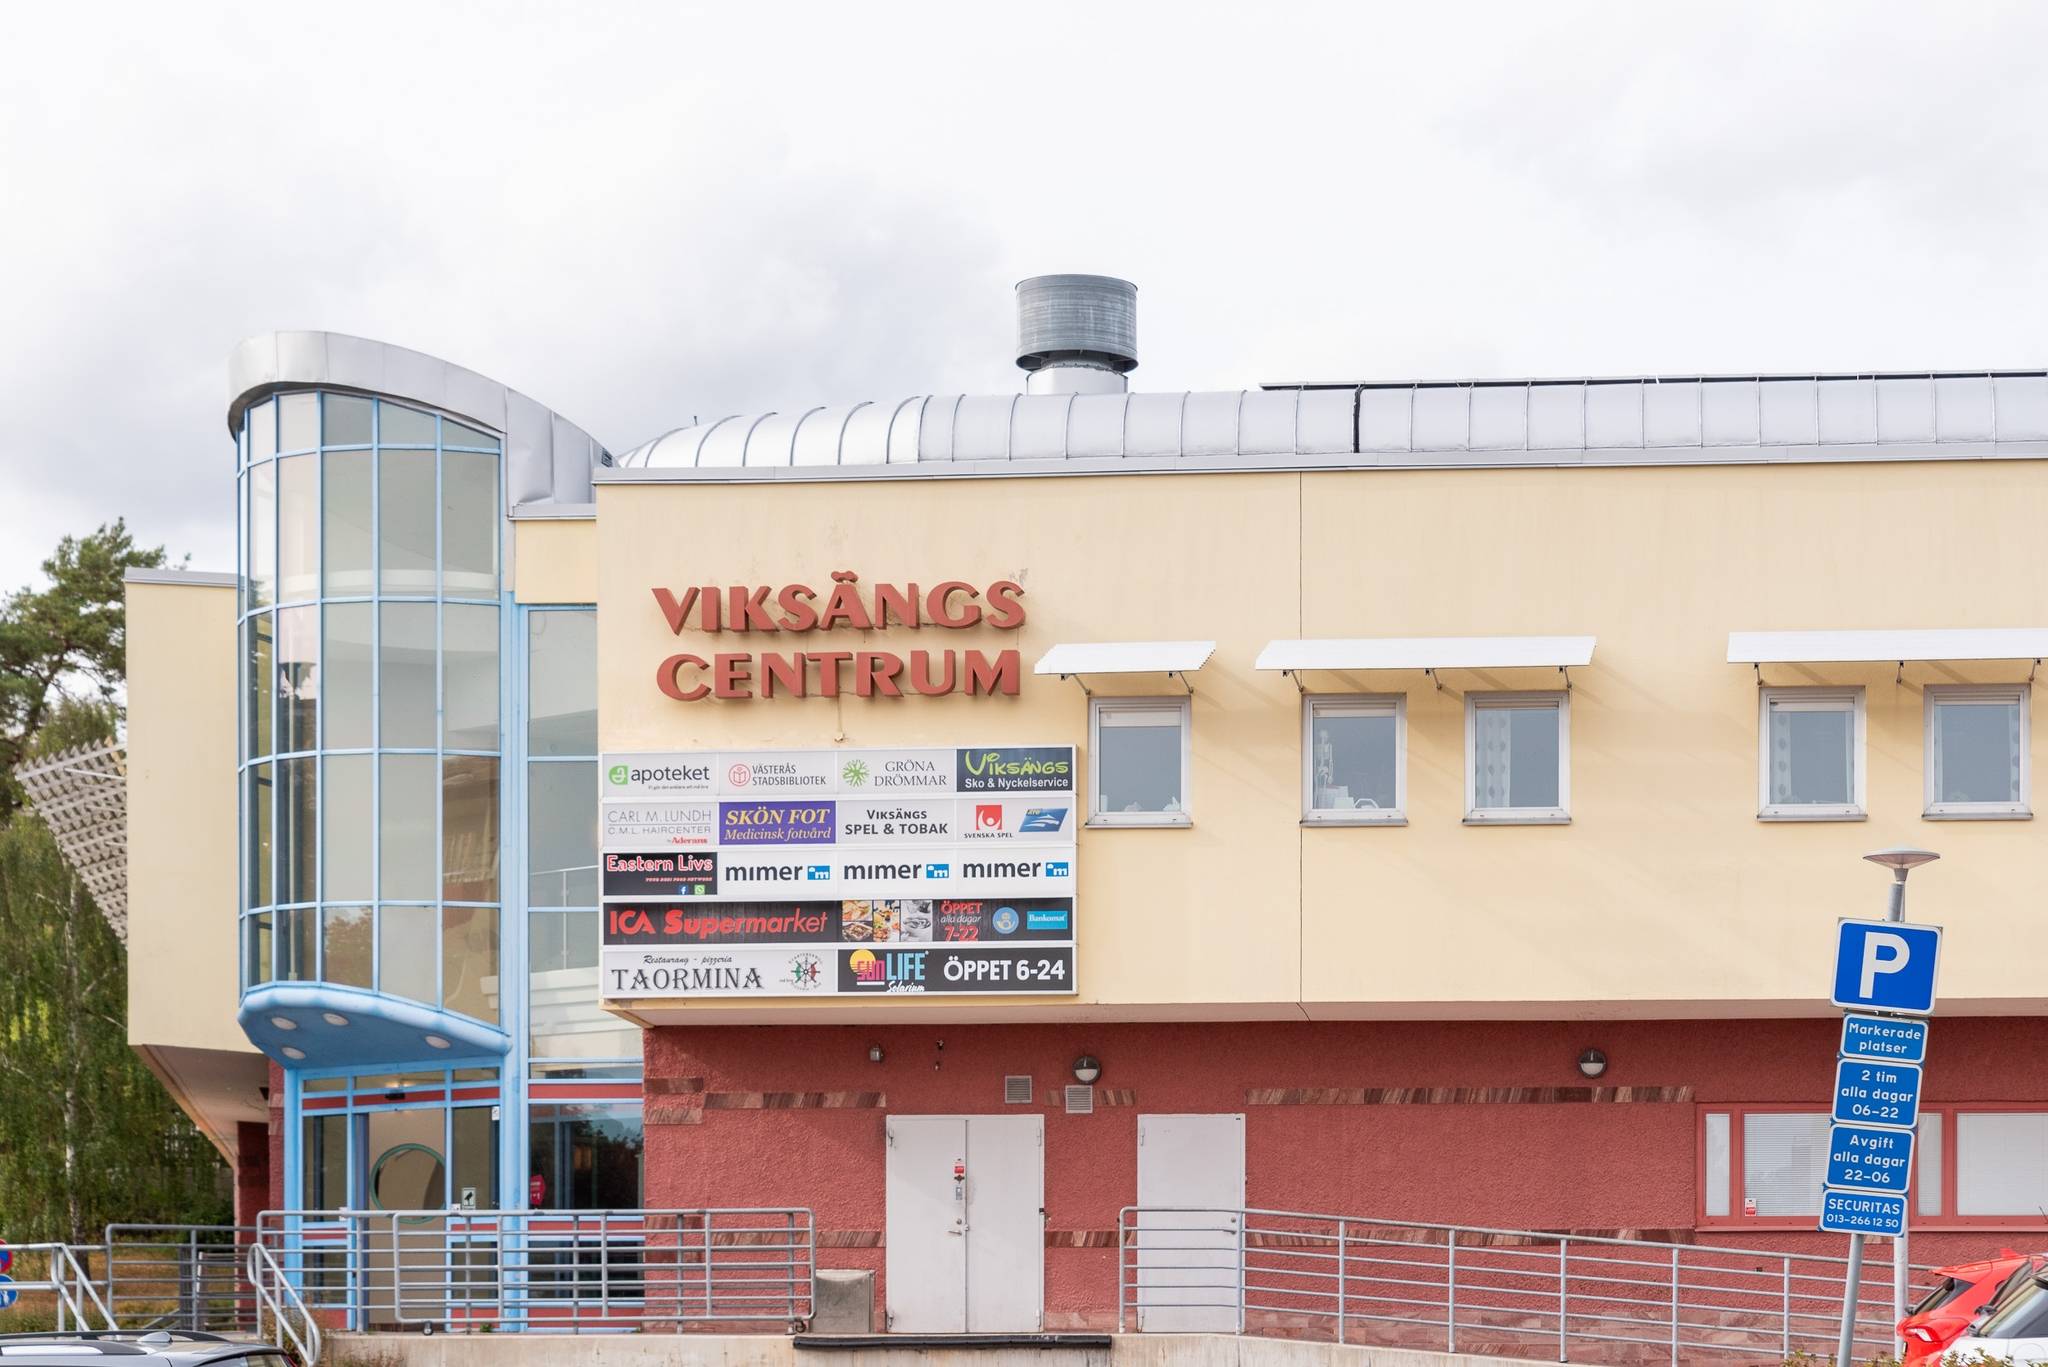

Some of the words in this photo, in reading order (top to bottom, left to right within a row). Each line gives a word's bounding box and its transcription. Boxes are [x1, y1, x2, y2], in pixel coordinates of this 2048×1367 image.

[651, 571, 1026, 636] VIKSÄNGS
[656, 650, 1021, 702] CENTRUM
[752, 765, 797, 775] VÄSTERÅS
[885, 758, 935, 772] GRÖNA
[631, 766, 710, 785] apoteket
[752, 775, 827, 786] STADSBIBLIOTEK
[874, 774, 948, 787] DRÖMMAR
[965, 778, 985, 789] Sko
[987, 778, 995, 788] &
[998, 777, 1069, 790] Nyckelservice
[608, 810, 641, 823] CARL
[645, 810, 662, 823] M.
[665, 809, 712, 822] LUNDH
[725, 806, 785, 825] SKÖN
[788, 809, 831, 824] FOT
[643, 826, 711, 835] HAIRCENTER
[724, 827, 784, 841] Medicinsk
[785, 826, 831, 842] fotvård
[845, 824, 879, 835] SPEL
[883, 824, 895, 835] &
[899, 823, 948, 835] TOBAK
[606, 855, 674, 872] Eastern
[677, 854, 713, 872] Livs
[963, 862, 1041, 878] mimer
[725, 865, 803, 881] mimer
[843, 863, 922, 880] mimer
[941, 900, 983, 914] ÖPPET
[610, 910, 656, 935] ICA
[663, 907, 828, 940] Supermarket
[940, 914, 956, 924] alla
[957, 914, 982, 924] dagar
[944, 925, 979, 942] 7-22
[643, 955, 689, 966] Restaurang
[701, 956, 733, 966] pizzeria
[943, 955, 1012, 981] ÖPPET
[1016, 959, 1065, 981] 6-24
[1859, 931, 1911, 999] P
[611, 967, 764, 991] TAORMINA
[886, 980, 925, 992] Solarium
[1849, 1022, 1922, 1040] Markerade
[1859, 1040, 1907, 1053] platser
[1861, 1069, 1871, 1081] 2
[1876, 1071, 1897, 1083] tim
[1841, 1086, 1867, 1098] alla
[1872, 1087, 1914, 1104] dagar
[1852, 1104, 1899, 1119] 06-22
[1850, 1135, 1894, 1150] Avgift
[1833, 1151, 1859, 1163] alla
[1864, 1153, 1906, 1169] dagar
[1844, 1169, 1890, 1184] 22-06
[1828, 1198, 1900, 1214] SECURITAS
[1826, 1213, 1871, 1226] 013-266
[1873, 1217, 1882, 1227] 12
[1885, 1218, 1899, 1228] 50
